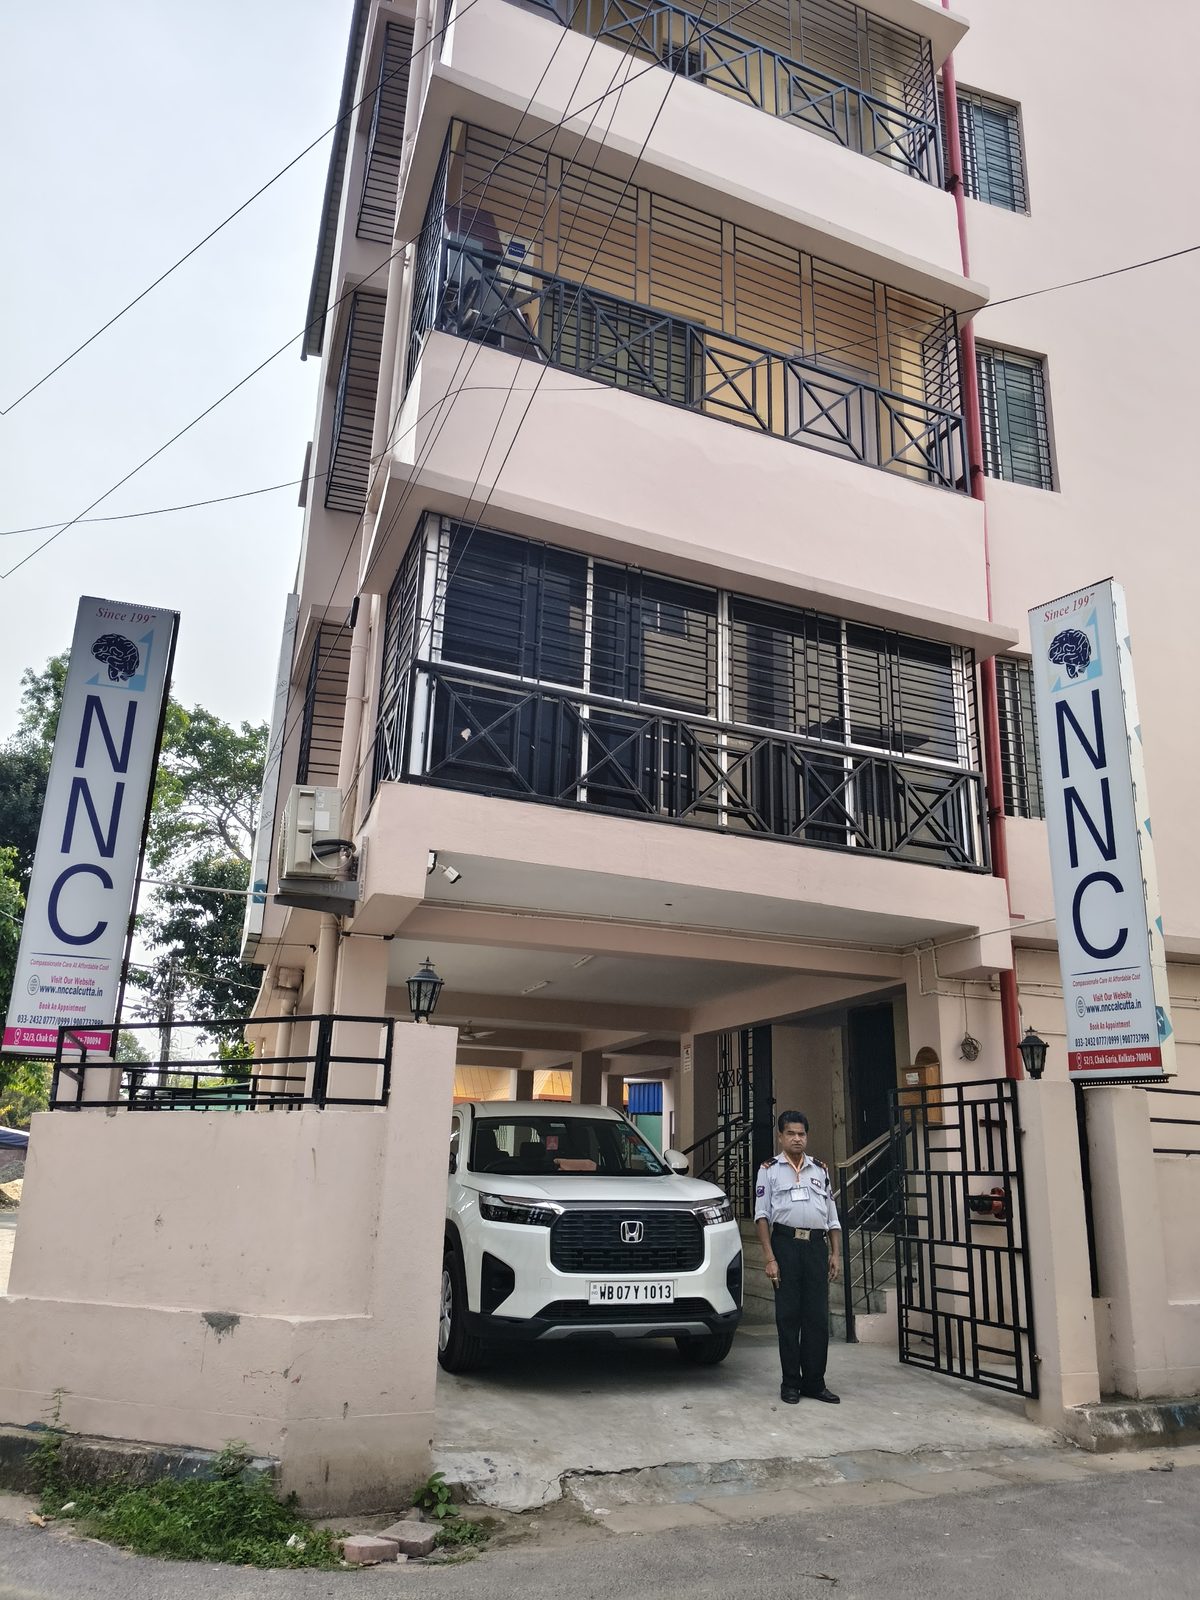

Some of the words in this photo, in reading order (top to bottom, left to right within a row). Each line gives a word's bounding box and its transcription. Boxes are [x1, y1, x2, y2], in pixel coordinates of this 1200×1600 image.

[95, 607, 127, 620] Since
[1043, 606, 1070, 622] Since
[50, 976, 62, 984] Visit
[64, 976, 73, 984] Our
[74, 977, 96, 986] Website
[40, 985, 103, 997] www.nnccalcutta.in
[1093, 993, 1103, 1002] Visit
[1104, 992, 1112, 1000] Our
[1113, 991, 1132, 1000] Website
[39, 1002, 50, 1010] Book
[57, 1003, 87, 1012] Appointment
[1086, 999, 1142, 1013] www.nnccalcutta.in
[1089, 1022, 1099, 1031] Book
[1105, 1020, 1131, 1031] Appointment
[36, 1033, 49, 1042] Chak
[1094, 1054, 1105, 1064] Chak
